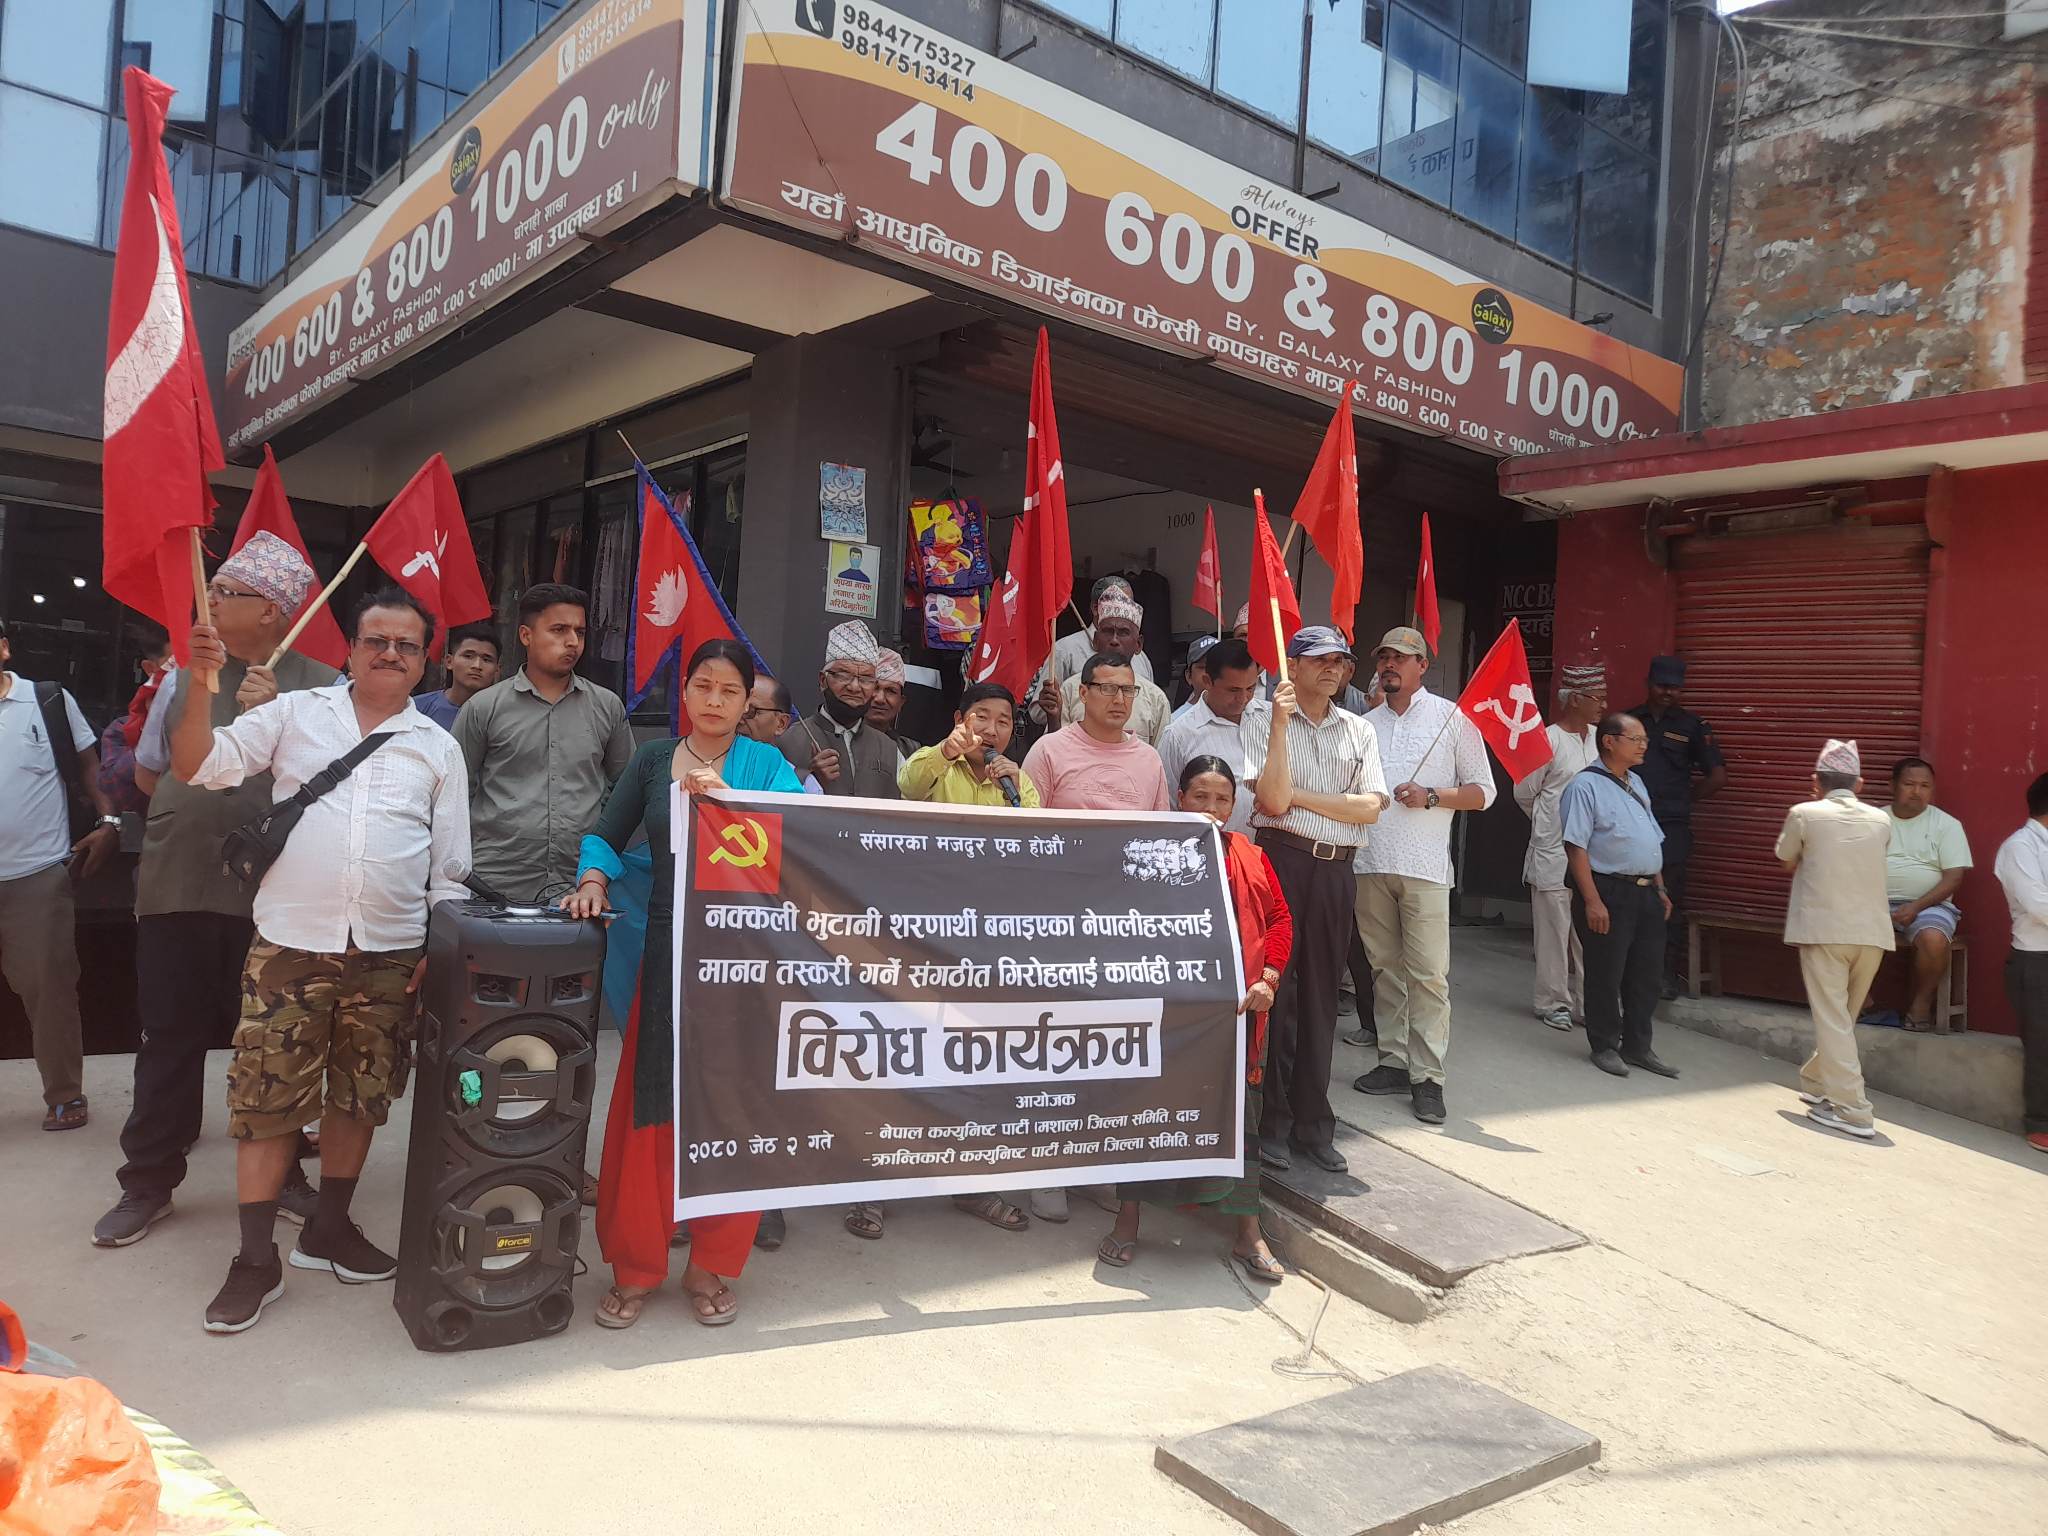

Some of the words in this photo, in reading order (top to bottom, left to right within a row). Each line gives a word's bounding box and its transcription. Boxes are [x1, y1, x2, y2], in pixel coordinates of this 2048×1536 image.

[842, 4, 976, 77] 9844775327
[841, 30, 975, 102] 9817513414
[245, 334, 286, 399] 400
[293, 291, 342, 367] 600
[352, 268, 375, 327] &
[387, 205, 453, 303] 800
[470, 96, 588, 241] 1000
[1231, 205, 1320, 261] OFFER
[875, 101, 1068, 233] 400
[1105, 191, 1255, 303] 600
[1283, 263, 1337, 338] &
[1361, 294, 1474, 386] 800
[1498, 349, 1619, 438] 1000
[349, 317, 390, 353] GALAXY
[392, 282, 442, 325] FASHION
[781, 179, 848, 222] यहाँ
[855, 204, 984, 270] आधुनिक
[1132, 304, 1202, 345] फेन्सी
[1459, 419, 1488, 441] ८००
[1474, 304, 1512, 333] Galaxy
[1278, 331, 1365, 375] GALAXY
[1374, 365, 1457, 408] FASHION
[1167, 511, 1196, 528] 1000
[859, 830, 928, 852] संसारका
[937, 836, 987, 858] मजदुर
[992, 838, 1022, 859] एक
[704, 900, 799, 932] नक्कली
[806, 907, 884, 941] भुटानी
[889, 907, 978, 940] शरणार्थी
[984, 912, 1076, 939] बनाइएका
[698, 958, 769, 986] मानव
[775, 955, 852, 988] तस्करी
[859, 957, 902, 988] गर्ने
[999, 956, 1098, 989] गिरोहलाई
[1175, 958, 1209, 985] गर
[787, 1008, 927, 1082] विरोध
[943, 1011, 1153, 1076] कार्यक्रम
[1015, 1090, 1076, 1110] आयोजक
[689, 1140, 738, 1164] २०८०
[748, 1133, 778, 1155] जेठ
[786, 1137, 798, 1156] २
[807, 1129, 835, 1152] गते
[879, 1122, 924, 1140] नेपाल
[1087, 1112, 1128, 1131] जिल्ला
[1062, 1138, 1100, 1156] नेपाल
[1103, 1135, 1145, 1155] जिल्ला
